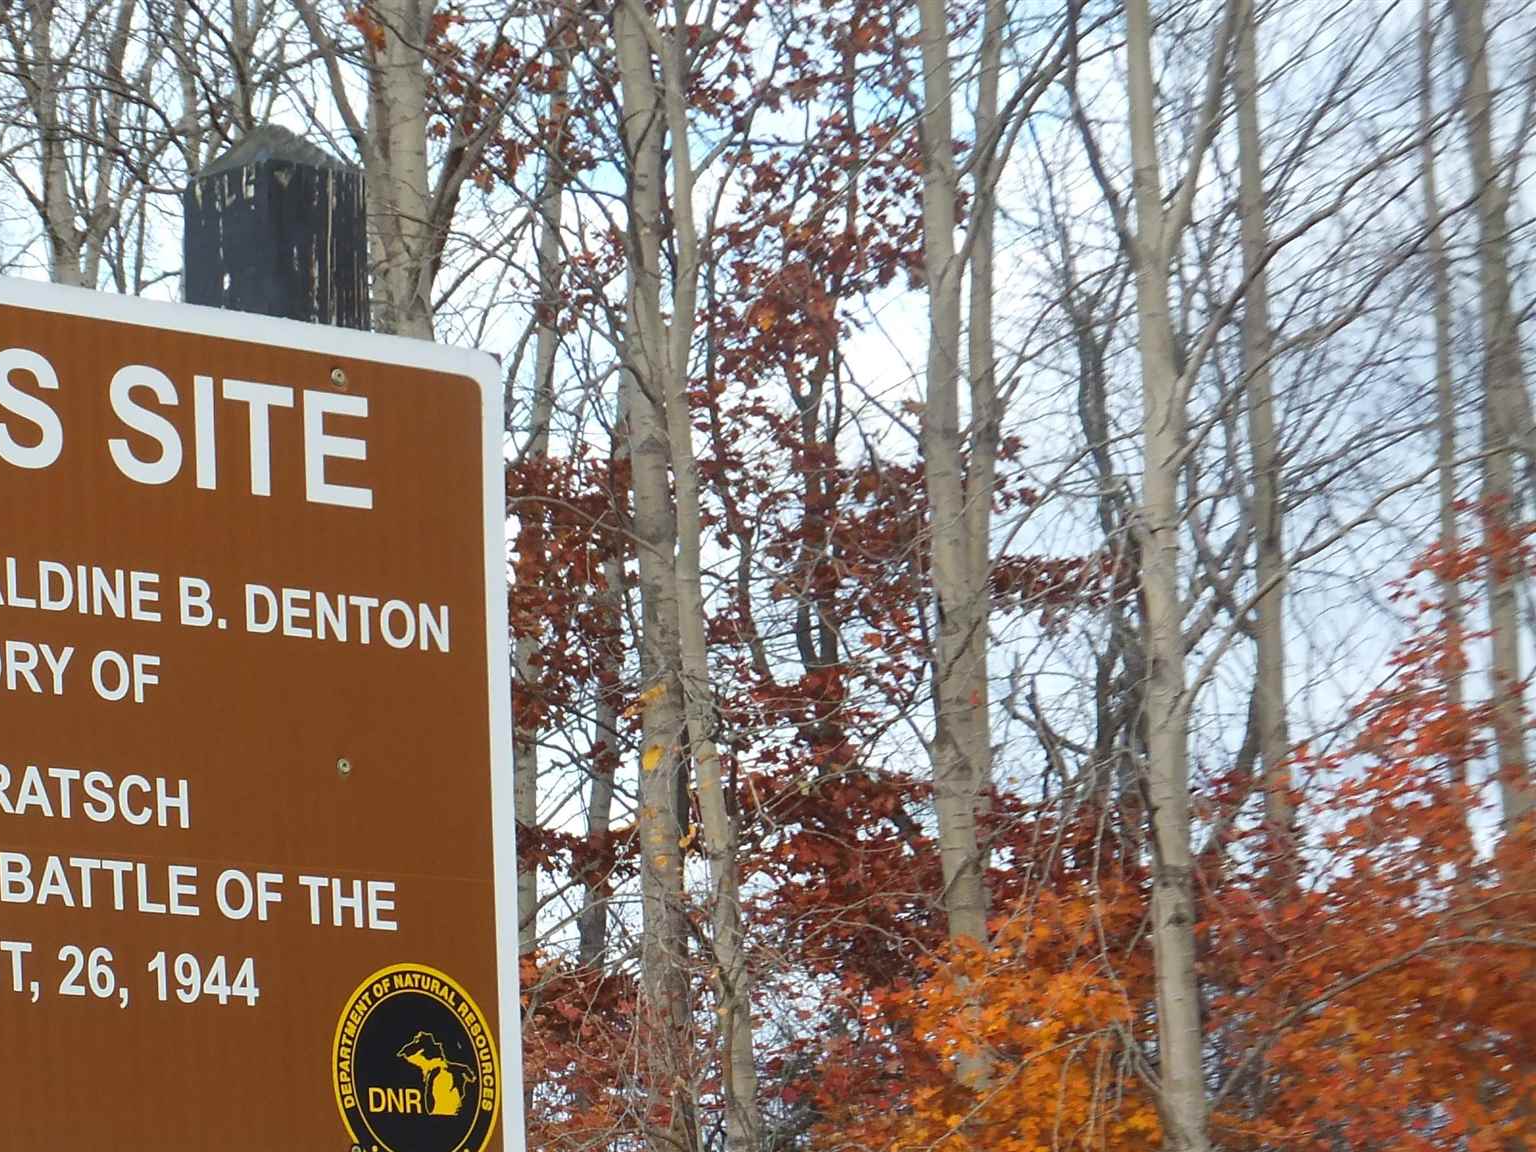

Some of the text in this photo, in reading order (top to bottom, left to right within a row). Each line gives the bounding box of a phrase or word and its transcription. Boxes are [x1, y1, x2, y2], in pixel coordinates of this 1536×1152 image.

[108, 365, 373, 509] SITE
[180, 577, 227, 630] B.
[246, 584, 449, 652] DENTON
[92, 651, 160, 703] OF
[0, 852, 199, 915] BATTLE
[216, 870, 283, 920] OF
[299, 876, 397, 930] THE
[58, 946, 129, 1008] 26,
[148, 952, 259, 1006] 1944
[337, 973, 494, 1112] DEPARTMENT OF NATURAL RESOURCES
[367, 1087, 423, 1114] DNR
